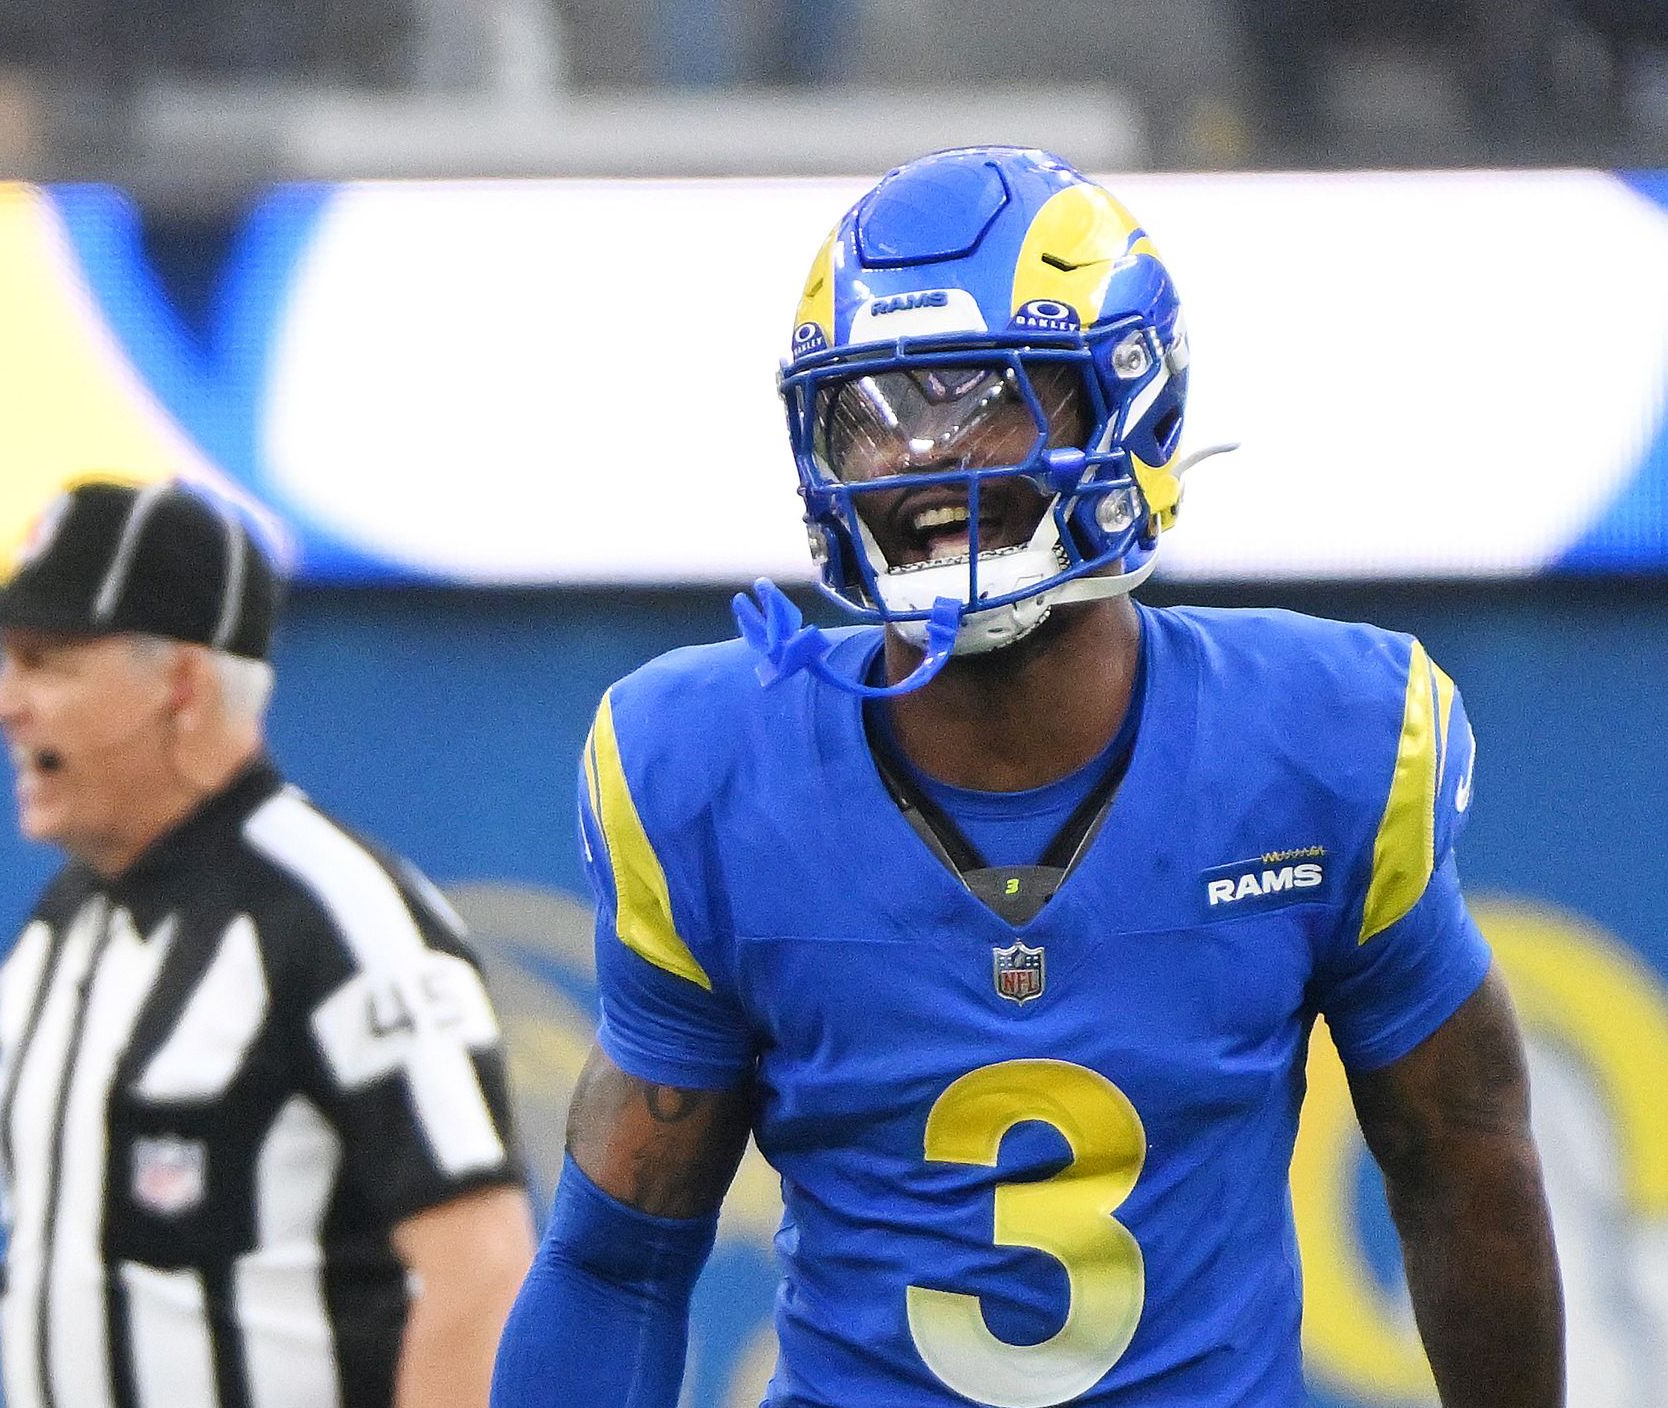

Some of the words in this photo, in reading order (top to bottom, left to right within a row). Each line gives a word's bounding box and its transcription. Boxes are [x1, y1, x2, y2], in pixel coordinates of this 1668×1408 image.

[870, 291, 948, 317] RAMS
[1016, 315, 1077, 333] OAKLEY
[1005, 878, 1020, 895] 3
[1207, 863, 1323, 906] RAMS
[1002, 971, 1038, 993] NFL
